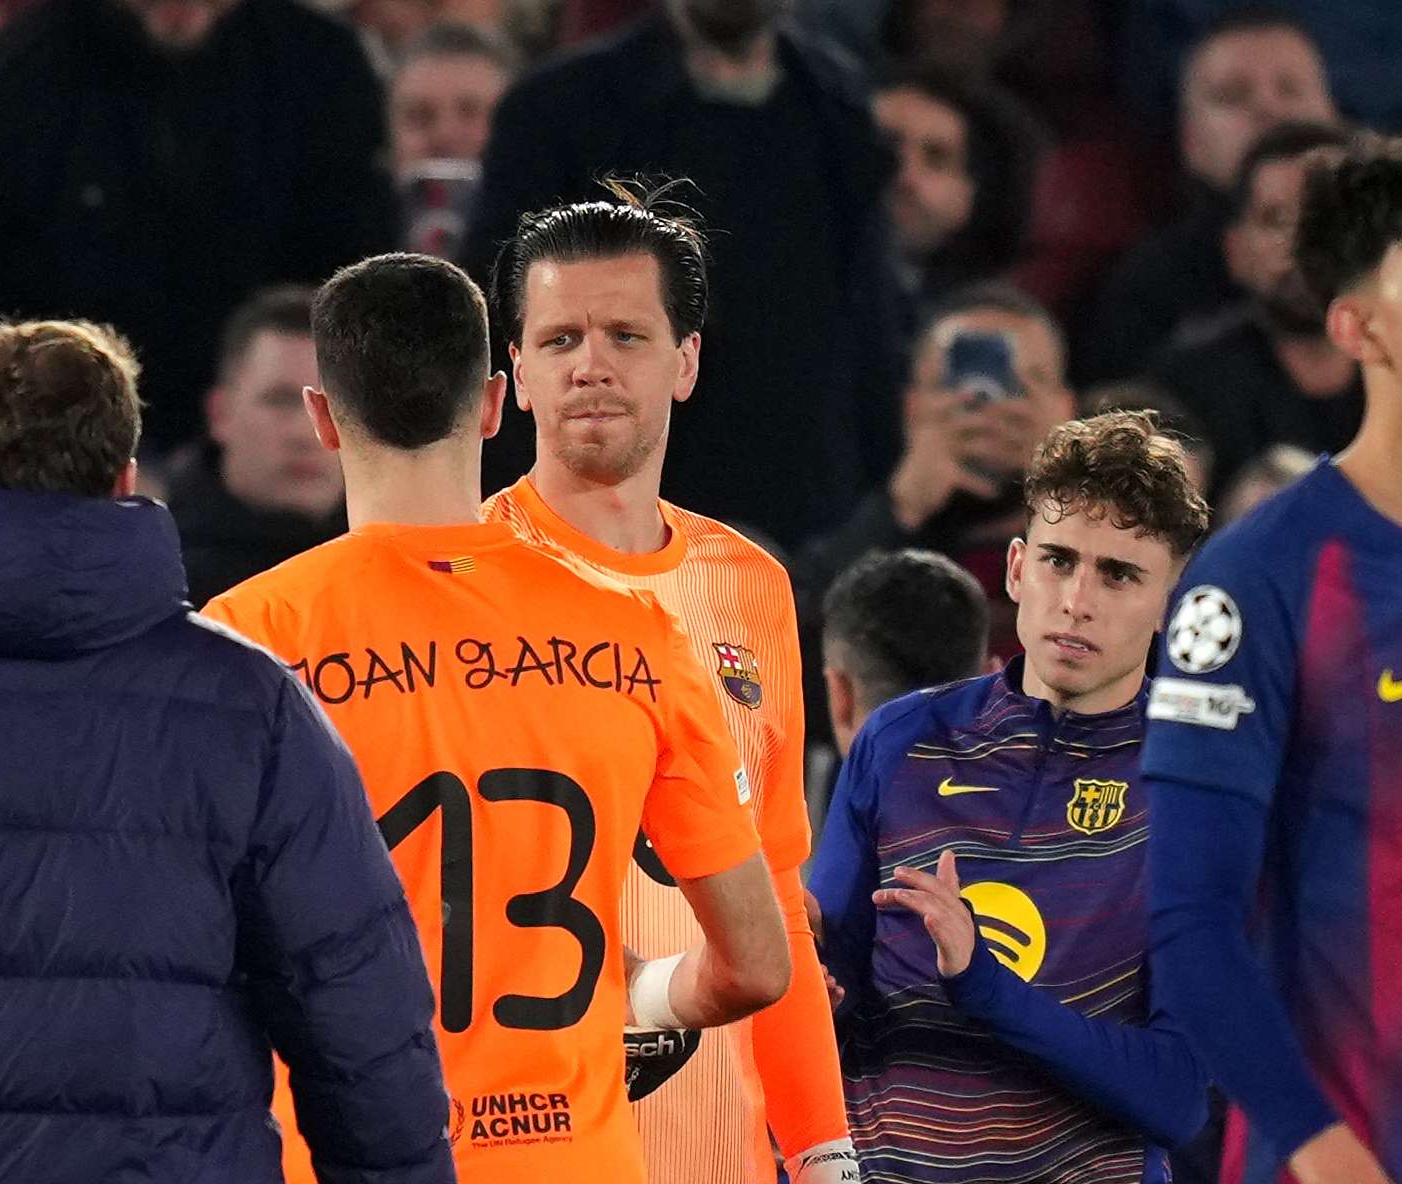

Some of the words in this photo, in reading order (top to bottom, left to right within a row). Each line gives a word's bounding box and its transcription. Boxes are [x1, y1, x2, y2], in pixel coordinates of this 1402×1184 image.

[377, 768, 606, 1033] 13
[624, 1034, 674, 1057] sch
[472, 1094, 569, 1117] UNHCR
[471, 1112, 571, 1140] ACNUR
